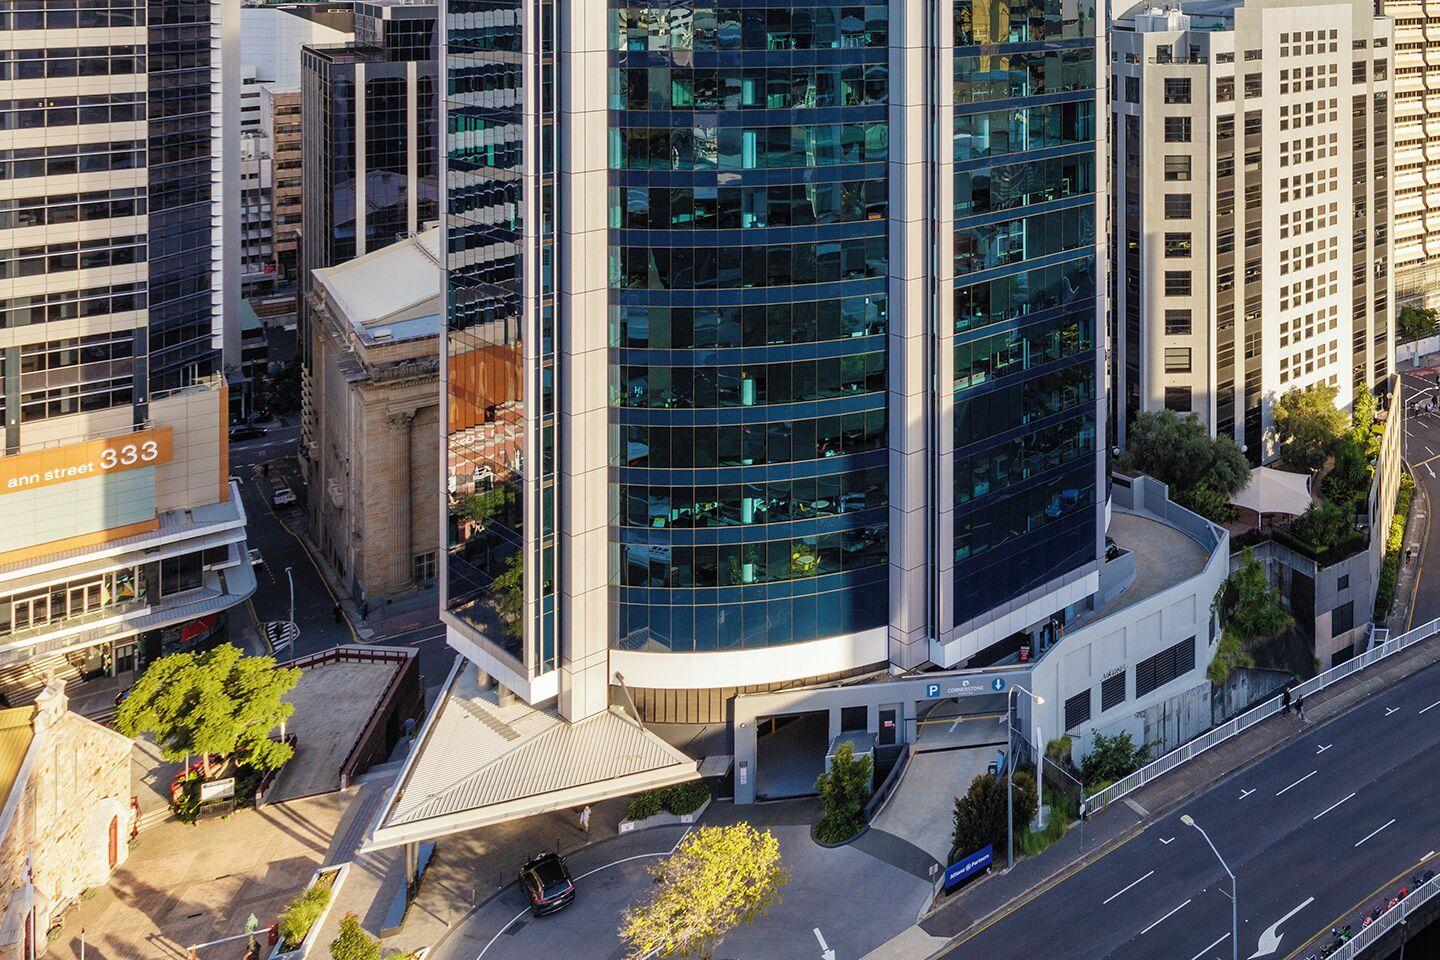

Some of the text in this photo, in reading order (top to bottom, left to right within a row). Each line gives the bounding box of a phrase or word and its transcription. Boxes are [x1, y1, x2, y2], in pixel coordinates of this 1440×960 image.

[7, 440, 159, 488] ann street 333
[929, 685, 938, 696] P
[947, 685, 984, 694] CORNERSTONE
